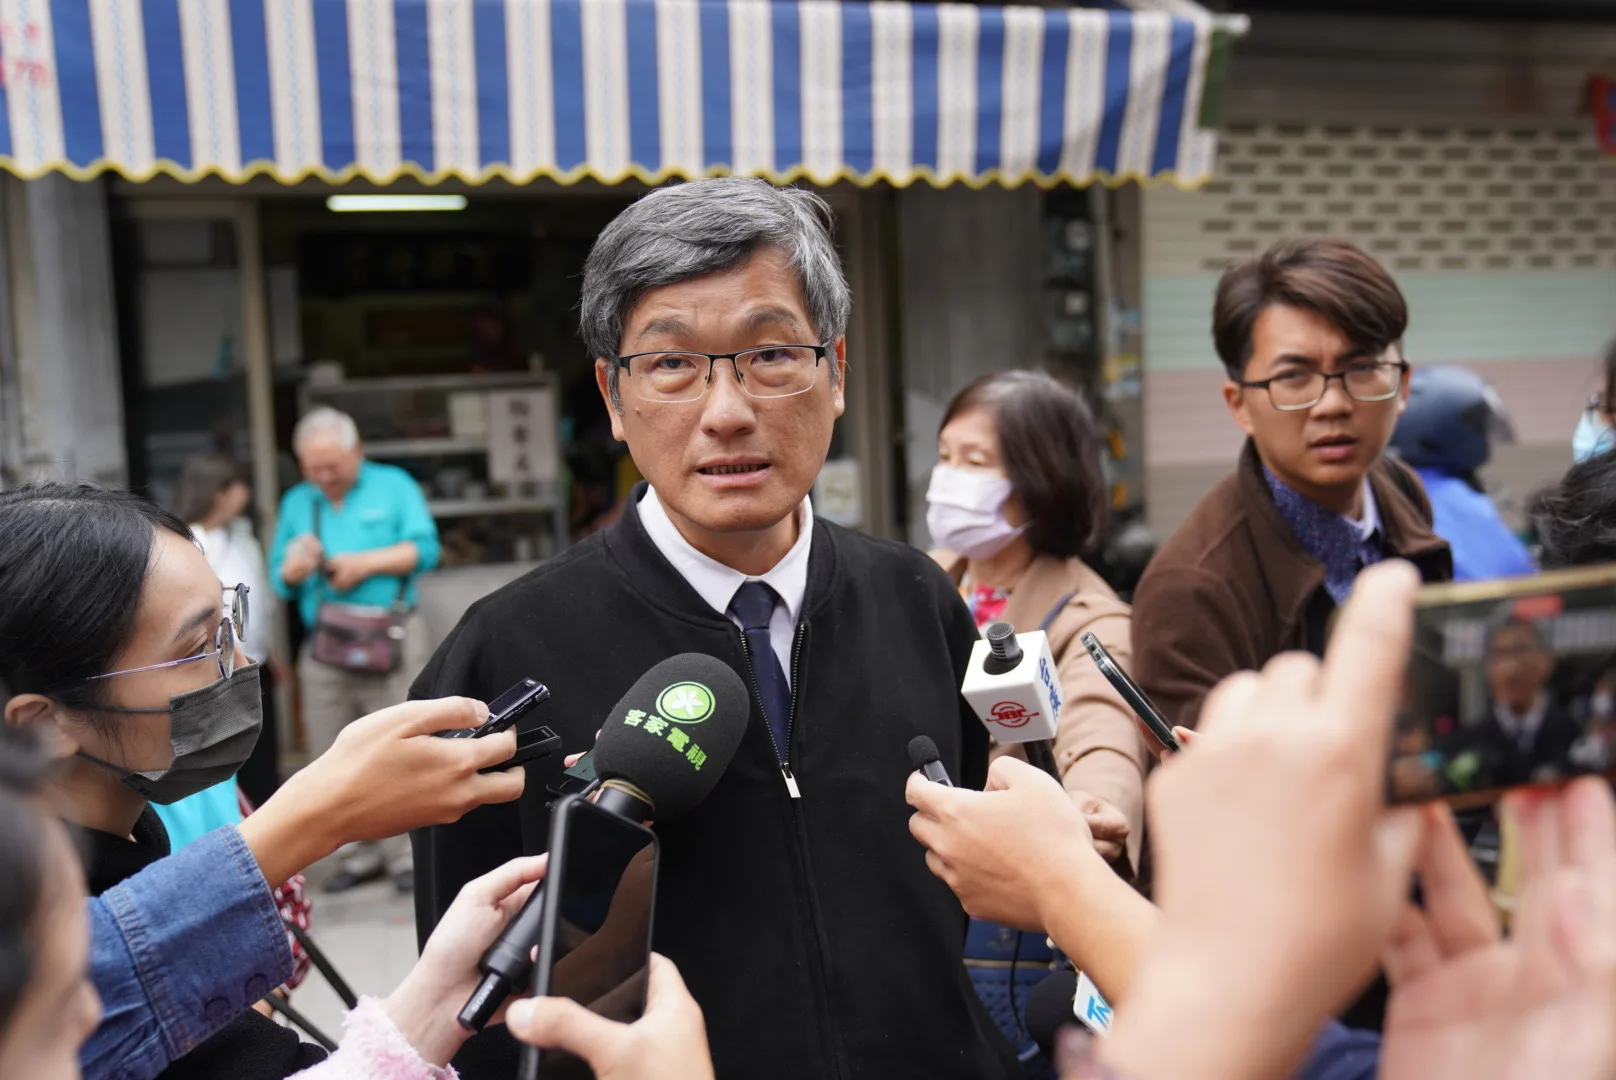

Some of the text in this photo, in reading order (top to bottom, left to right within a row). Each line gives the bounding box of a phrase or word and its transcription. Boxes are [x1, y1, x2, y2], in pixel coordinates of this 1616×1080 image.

[624, 709, 707, 771] 客家電視
[470, 982, 495, 1013] SONY
